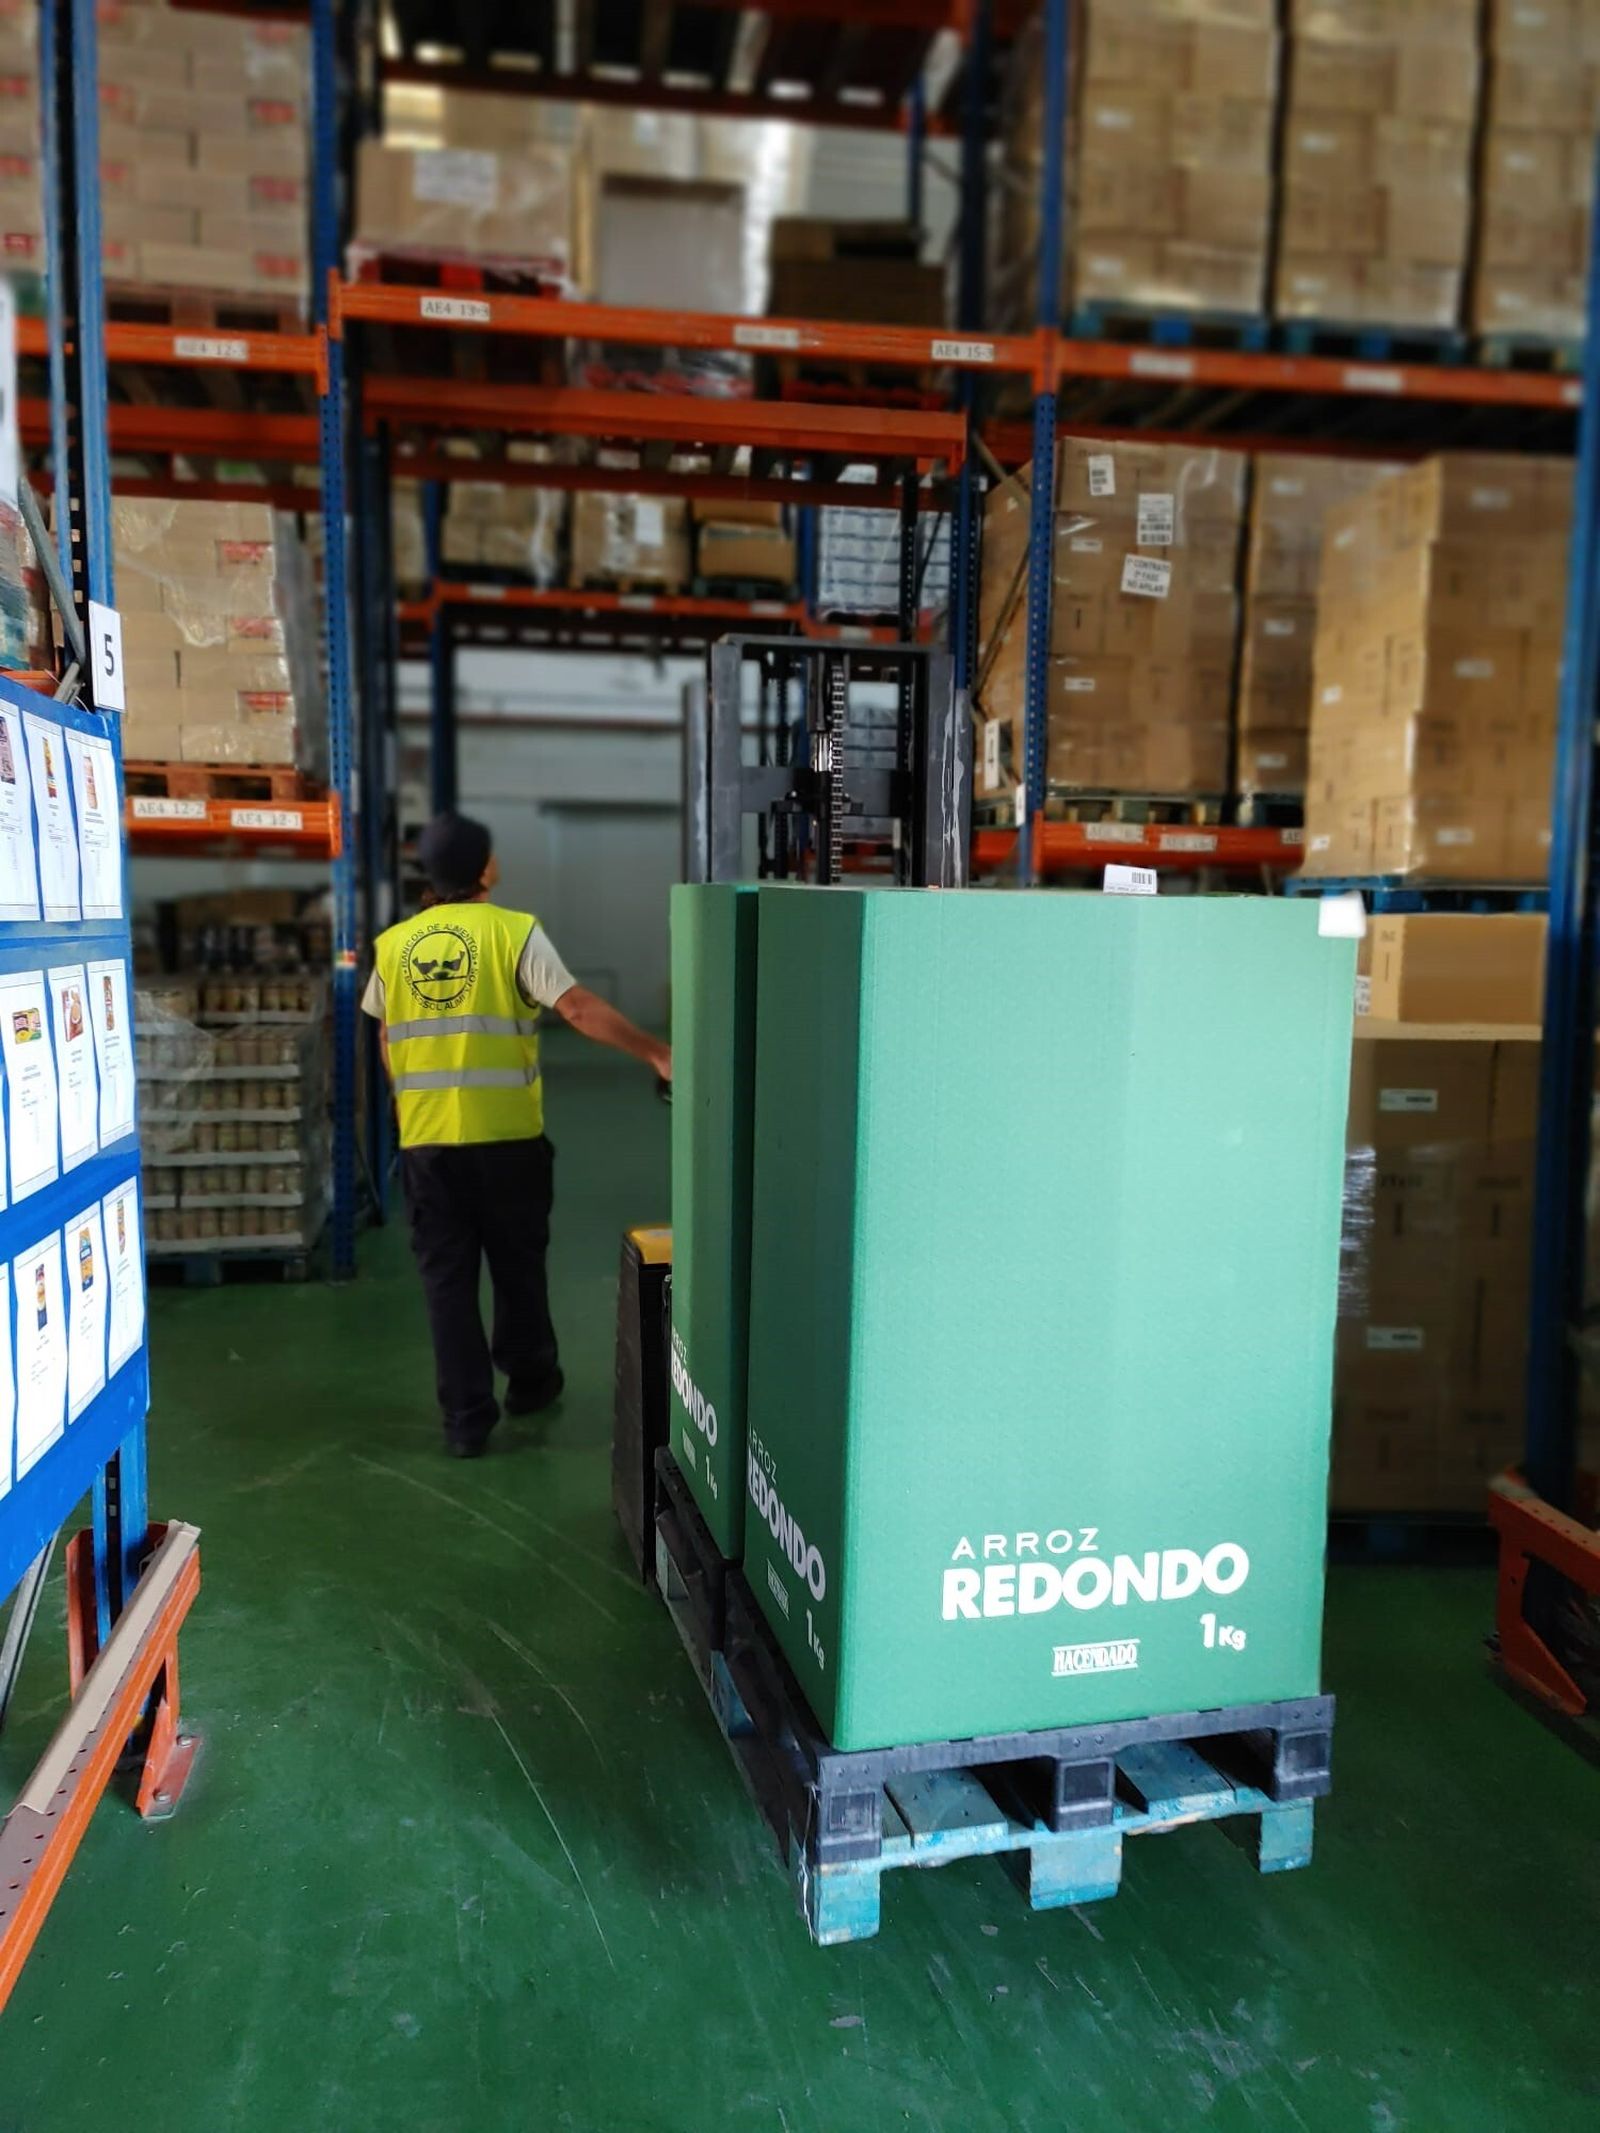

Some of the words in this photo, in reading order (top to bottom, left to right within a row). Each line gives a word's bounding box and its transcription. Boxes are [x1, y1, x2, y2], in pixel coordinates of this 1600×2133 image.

[424, 301, 451, 316] AE4
[935, 344, 960, 357] AE4
[104, 633, 114, 677] 5
[137, 803, 165, 815] AE4
[236, 812, 263, 825] AE4
[427, 923, 441, 932] DE
[951, 1527, 1100, 1561] ARROZ
[942, 1542, 1250, 1621] REDONDO
[1053, 1643, 1138, 1673] HACENDADO
